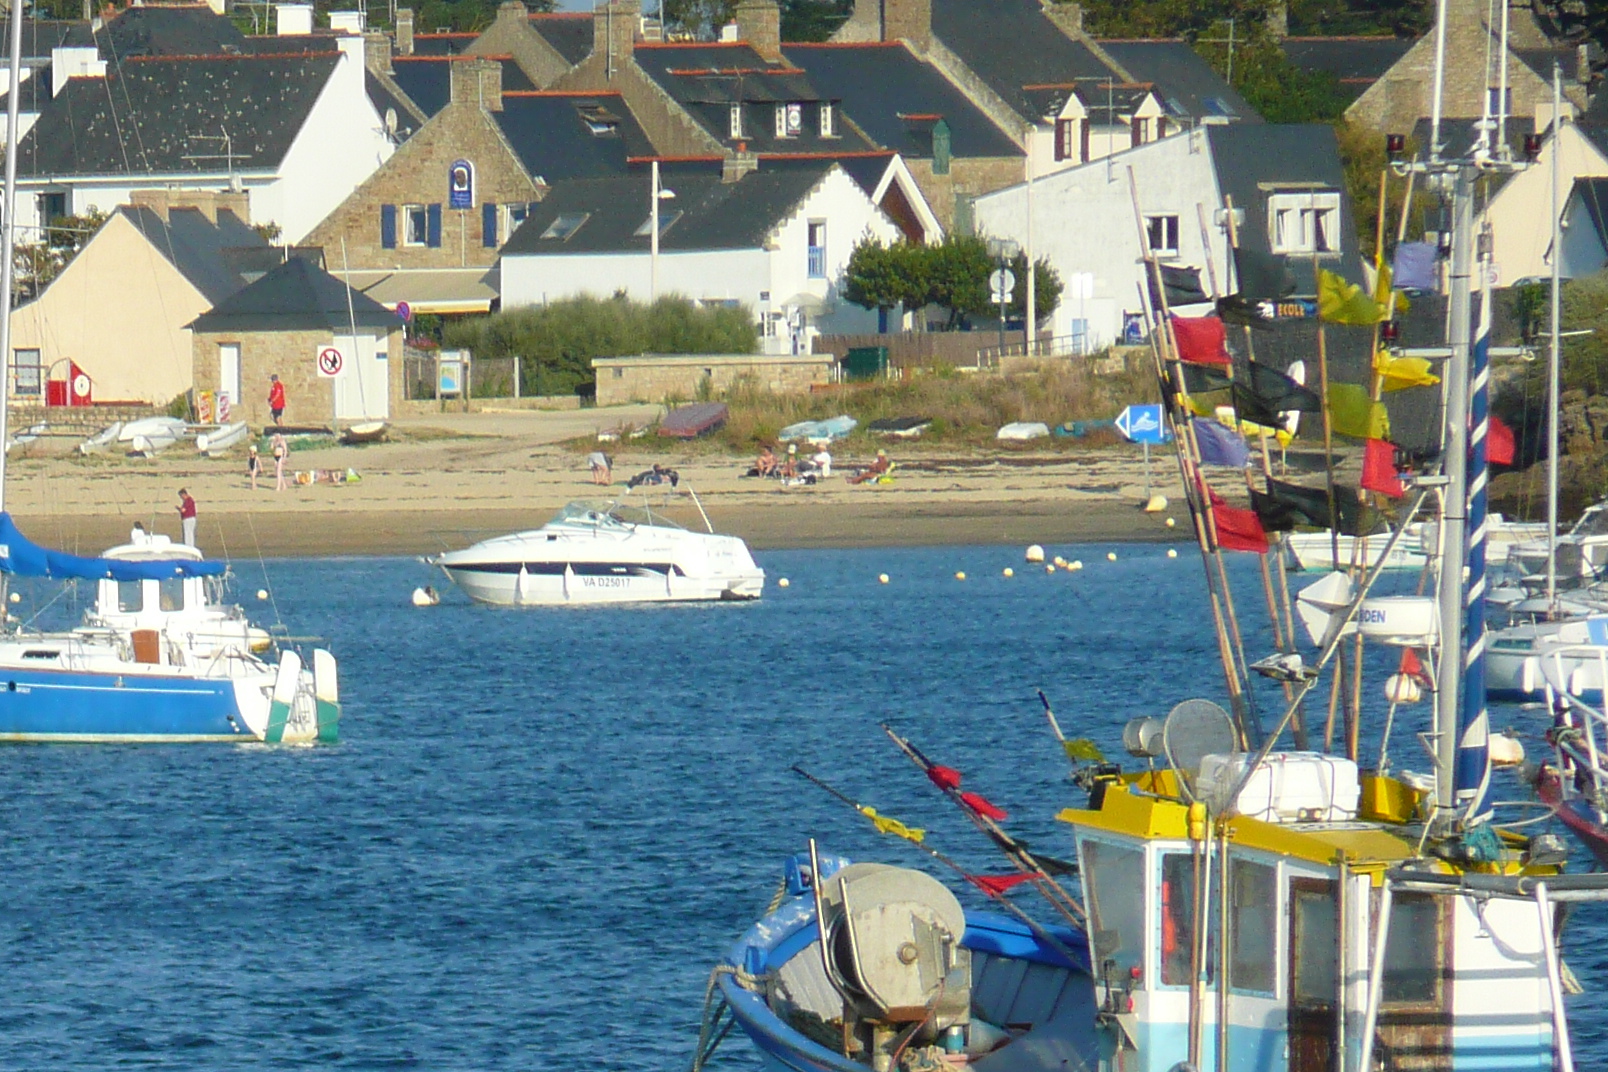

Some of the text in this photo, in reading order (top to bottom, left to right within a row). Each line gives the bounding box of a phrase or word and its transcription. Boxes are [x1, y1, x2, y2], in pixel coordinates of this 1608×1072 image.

[1277, 303, 1305, 317] ECOLE
[582, 577, 631, 588] VA D25017
